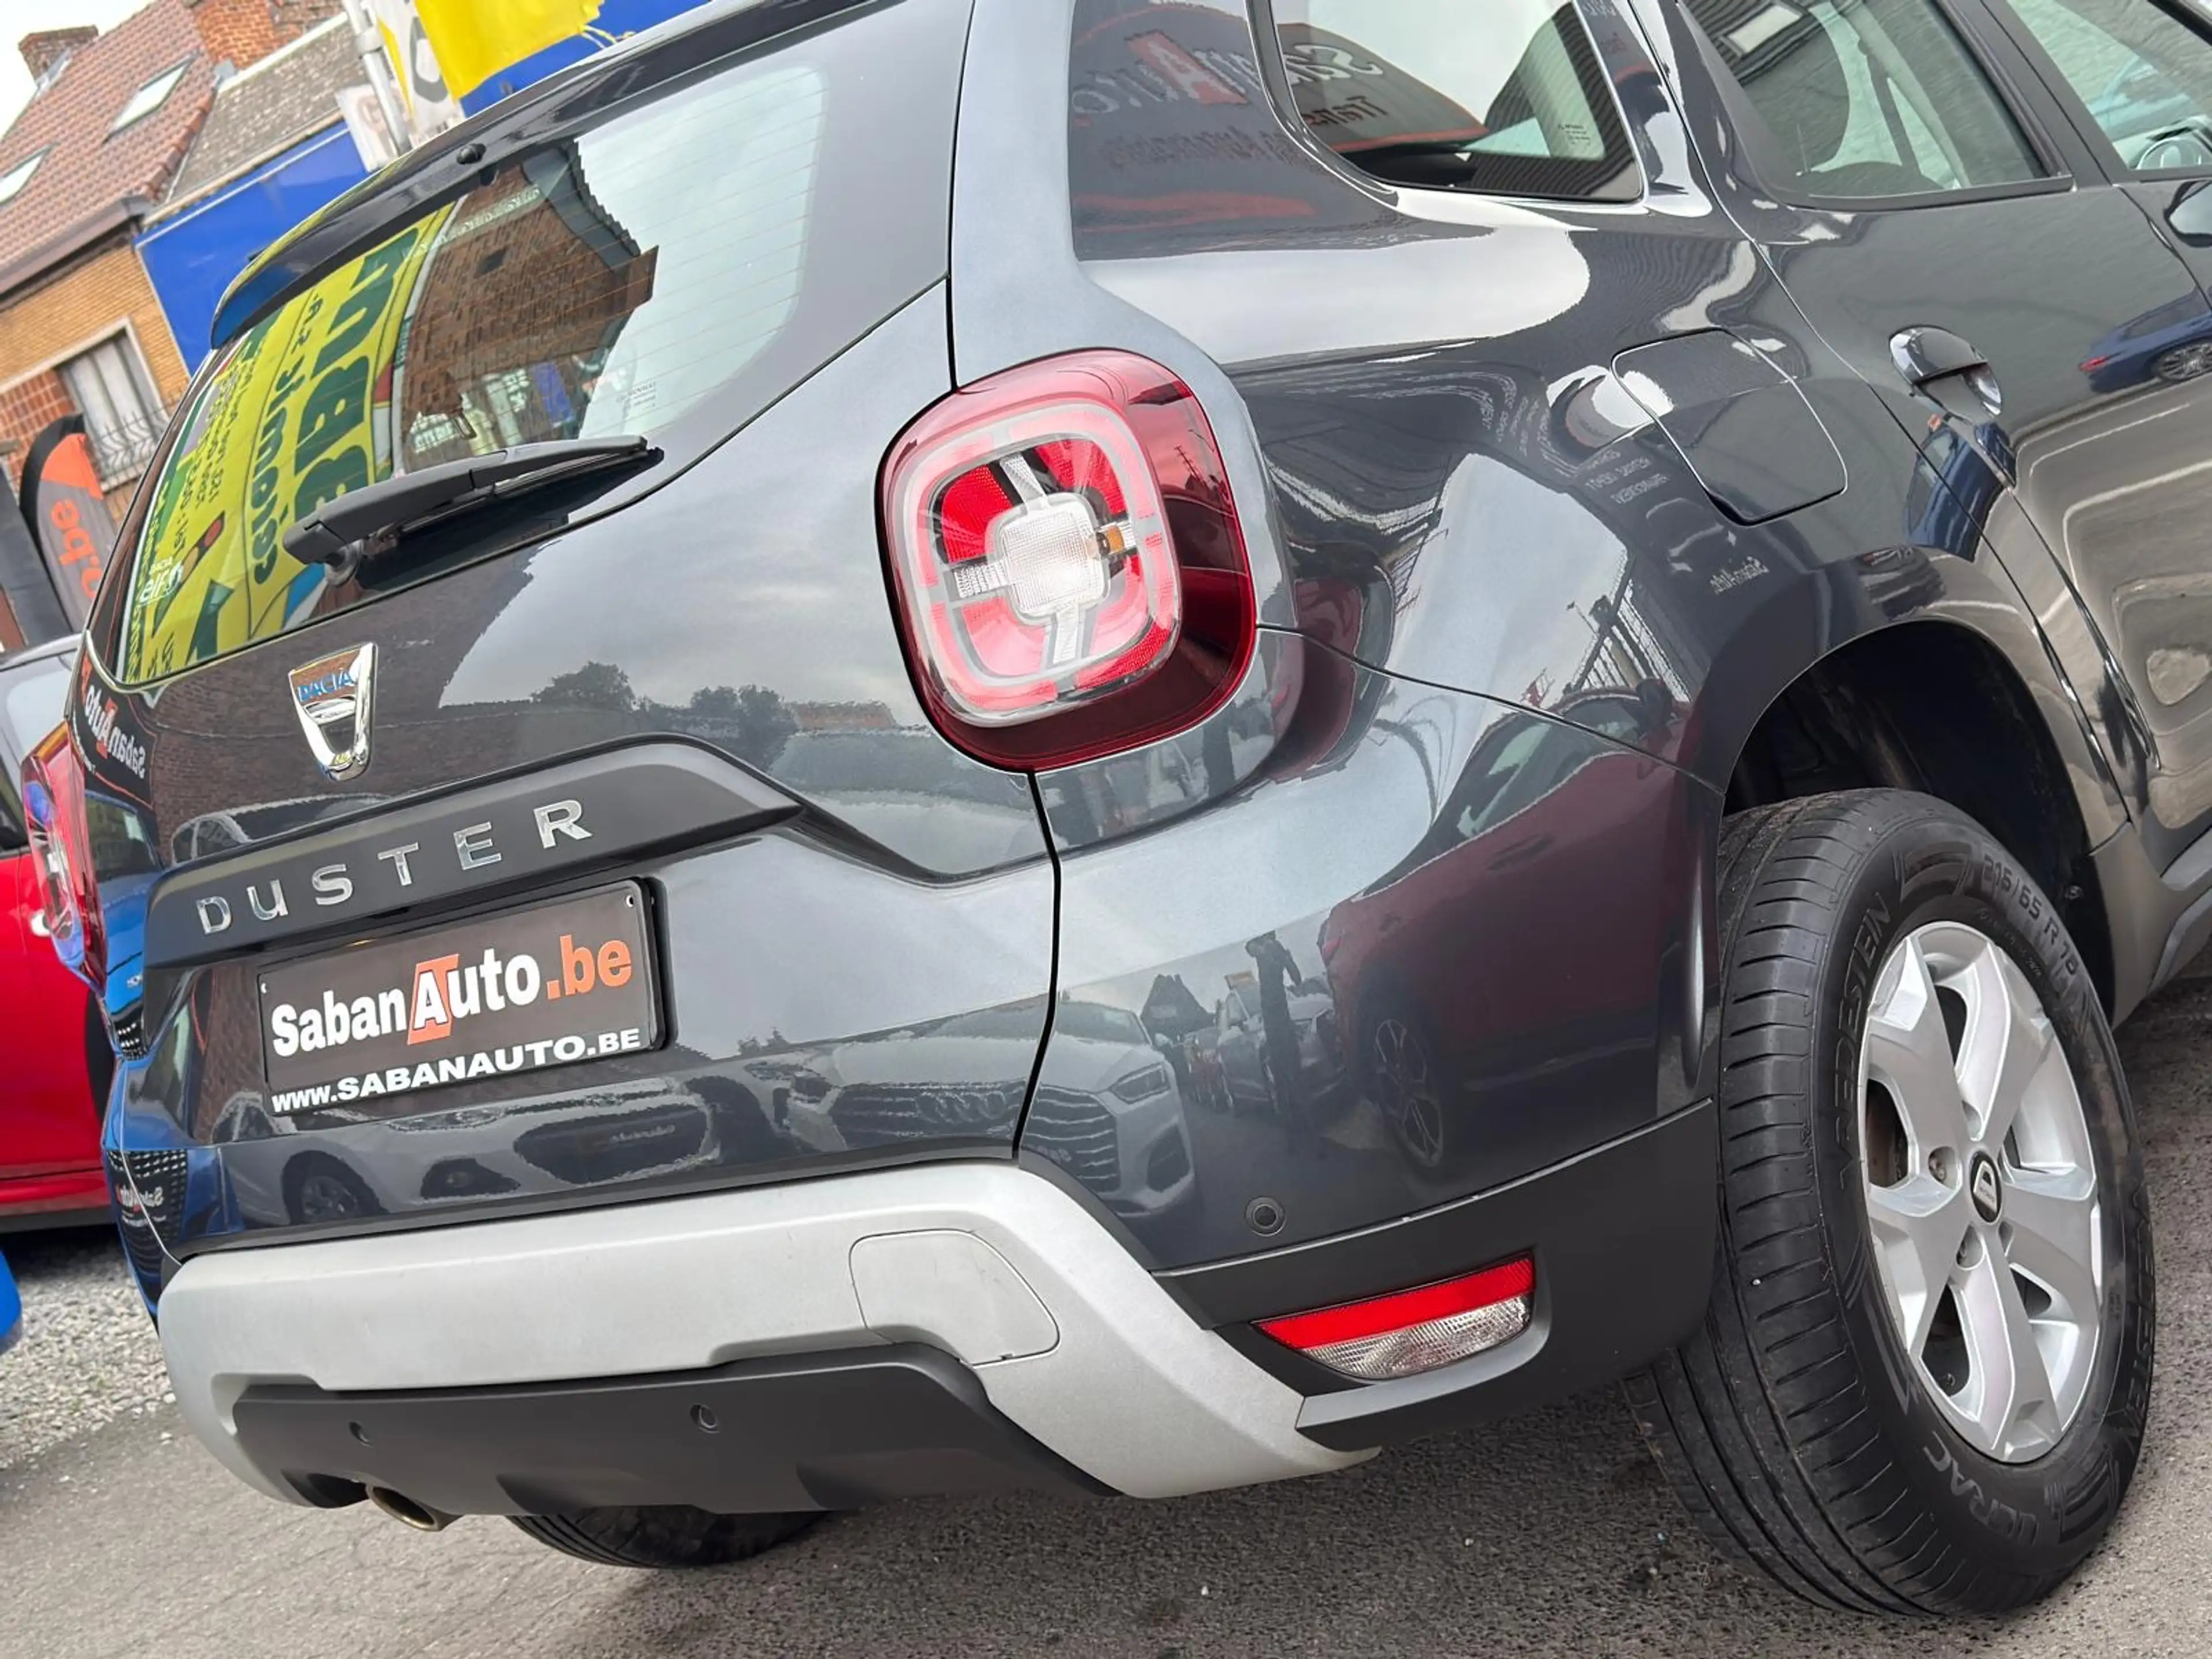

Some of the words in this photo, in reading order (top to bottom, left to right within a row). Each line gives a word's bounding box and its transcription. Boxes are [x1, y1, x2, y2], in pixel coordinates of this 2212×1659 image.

[297, 668, 356, 703] DACIA
[196, 800, 592, 934] DUSTER
[271, 934, 632, 1058] SabanAuto.be
